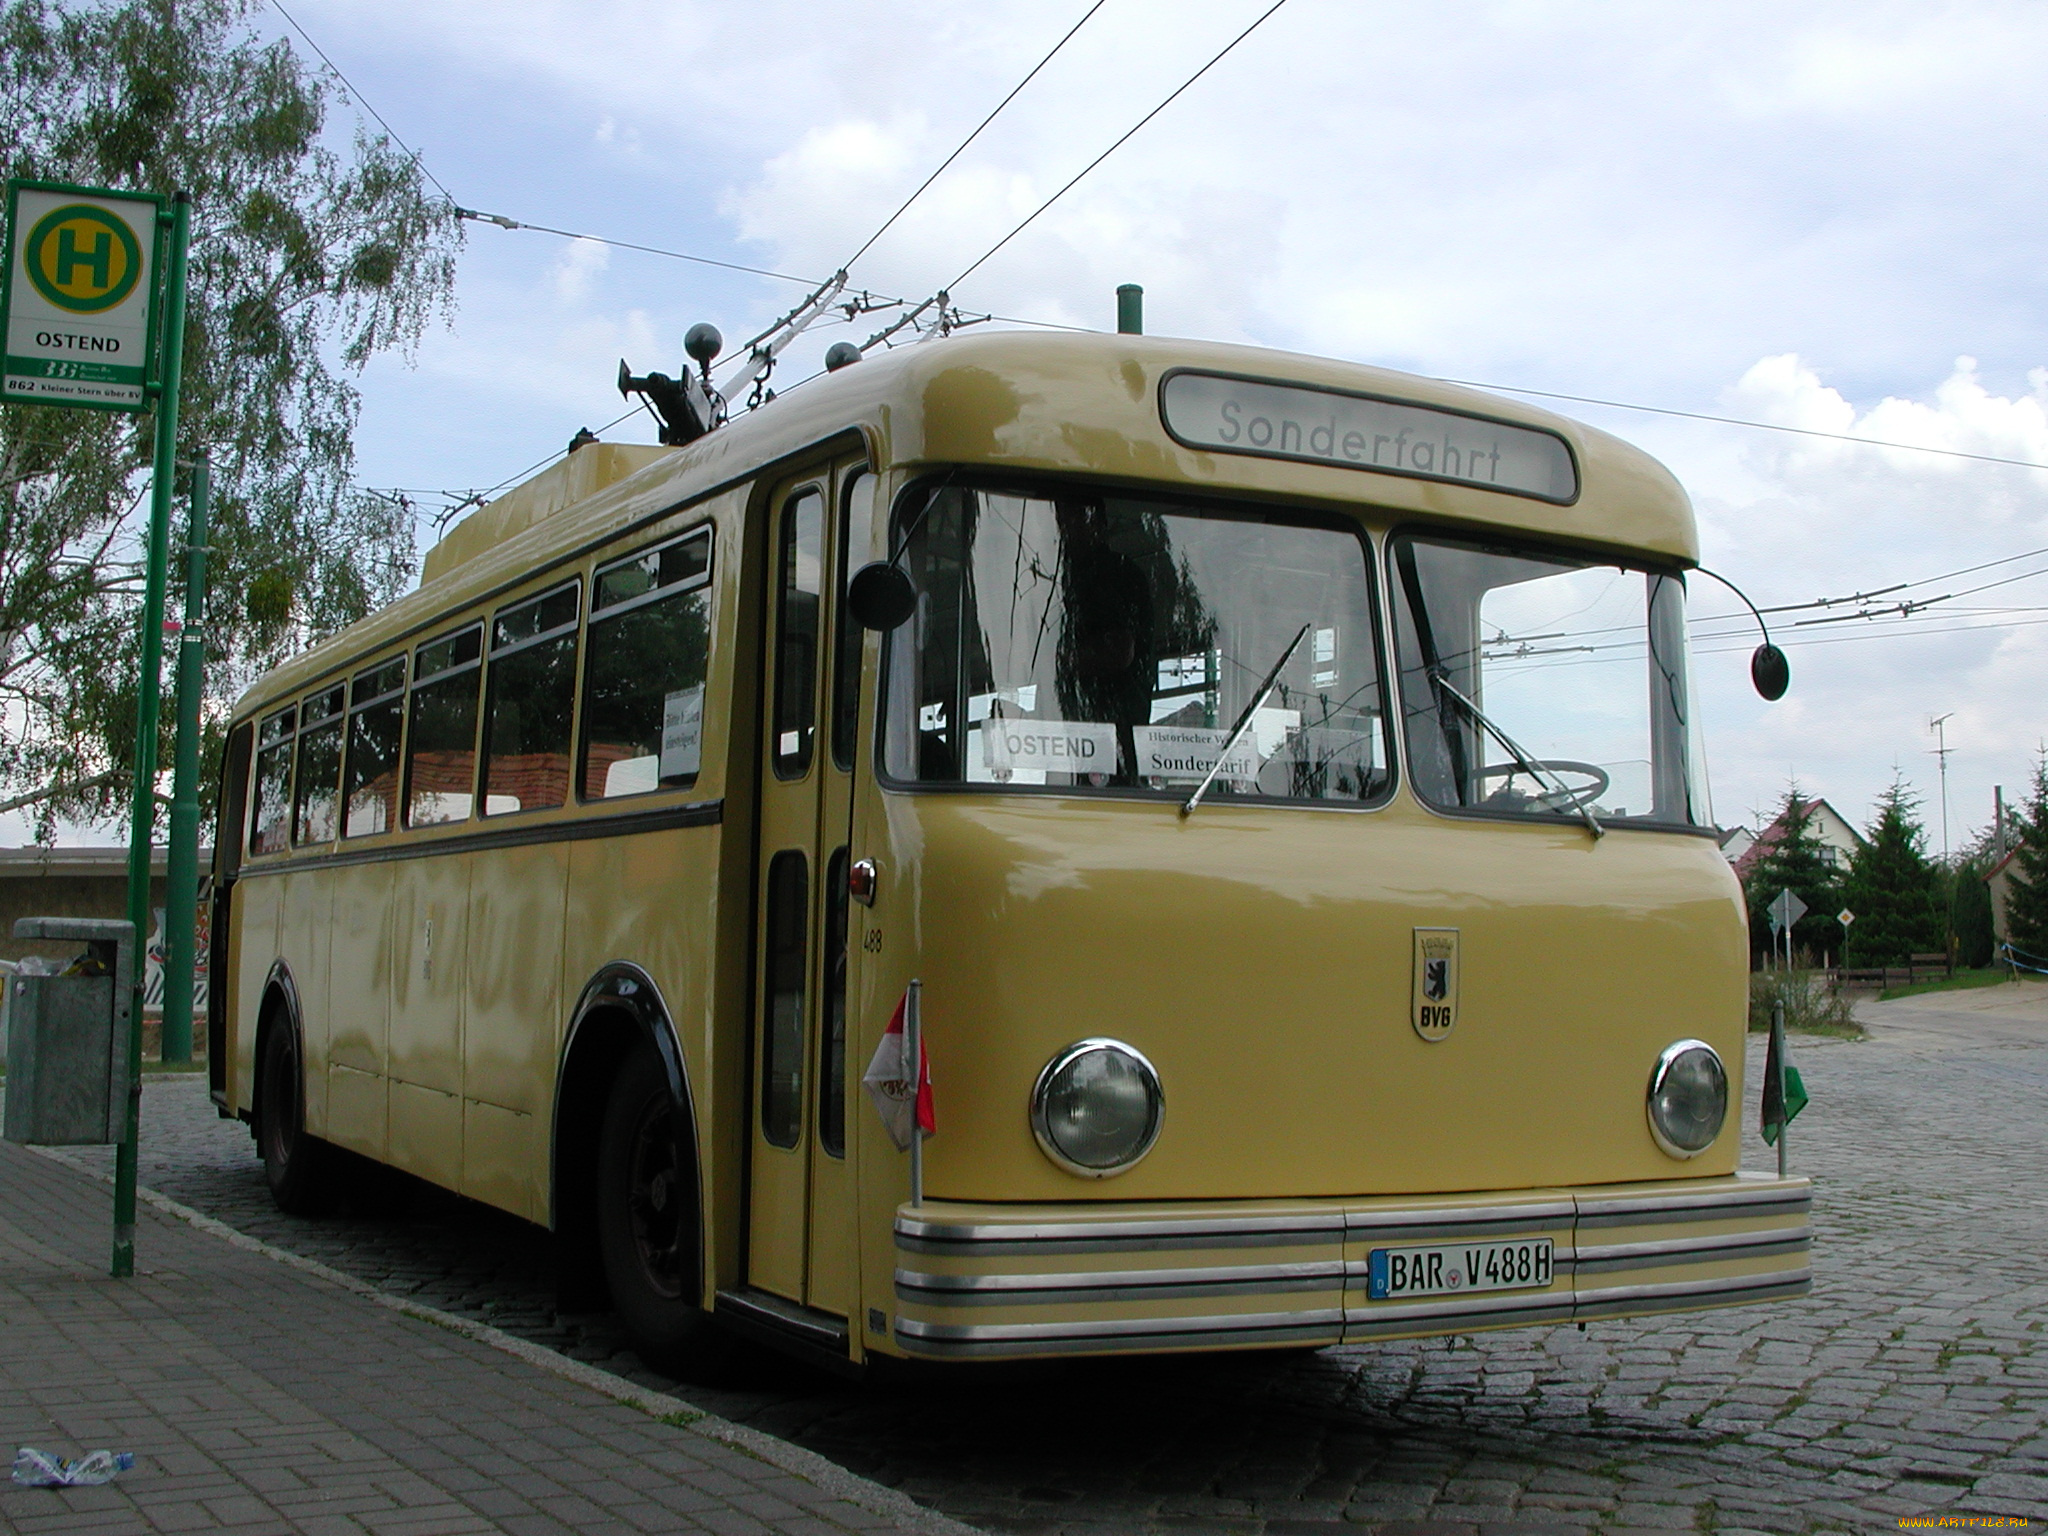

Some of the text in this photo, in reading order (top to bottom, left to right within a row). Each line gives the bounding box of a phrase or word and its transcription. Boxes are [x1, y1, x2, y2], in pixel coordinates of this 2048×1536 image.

[56, 229, 112, 289] H
[36, 331, 120, 353] OSTEND
[8, 380, 36, 392] 862
[41, 383, 75, 394] Kleiner
[77, 386, 102, 396] Stern
[104, 388, 125, 398] über
[1218, 400, 1501, 482] Sonderfahrt
[1007, 735, 1096, 758] OSTEND
[1149, 732, 1212, 744] Historischer
[864, 929, 882, 953] 488
[1421, 1006, 1451, 1027] BVG
[1391, 1252, 1443, 1290] BAR
[1466, 1244, 1549, 1286] V488H
